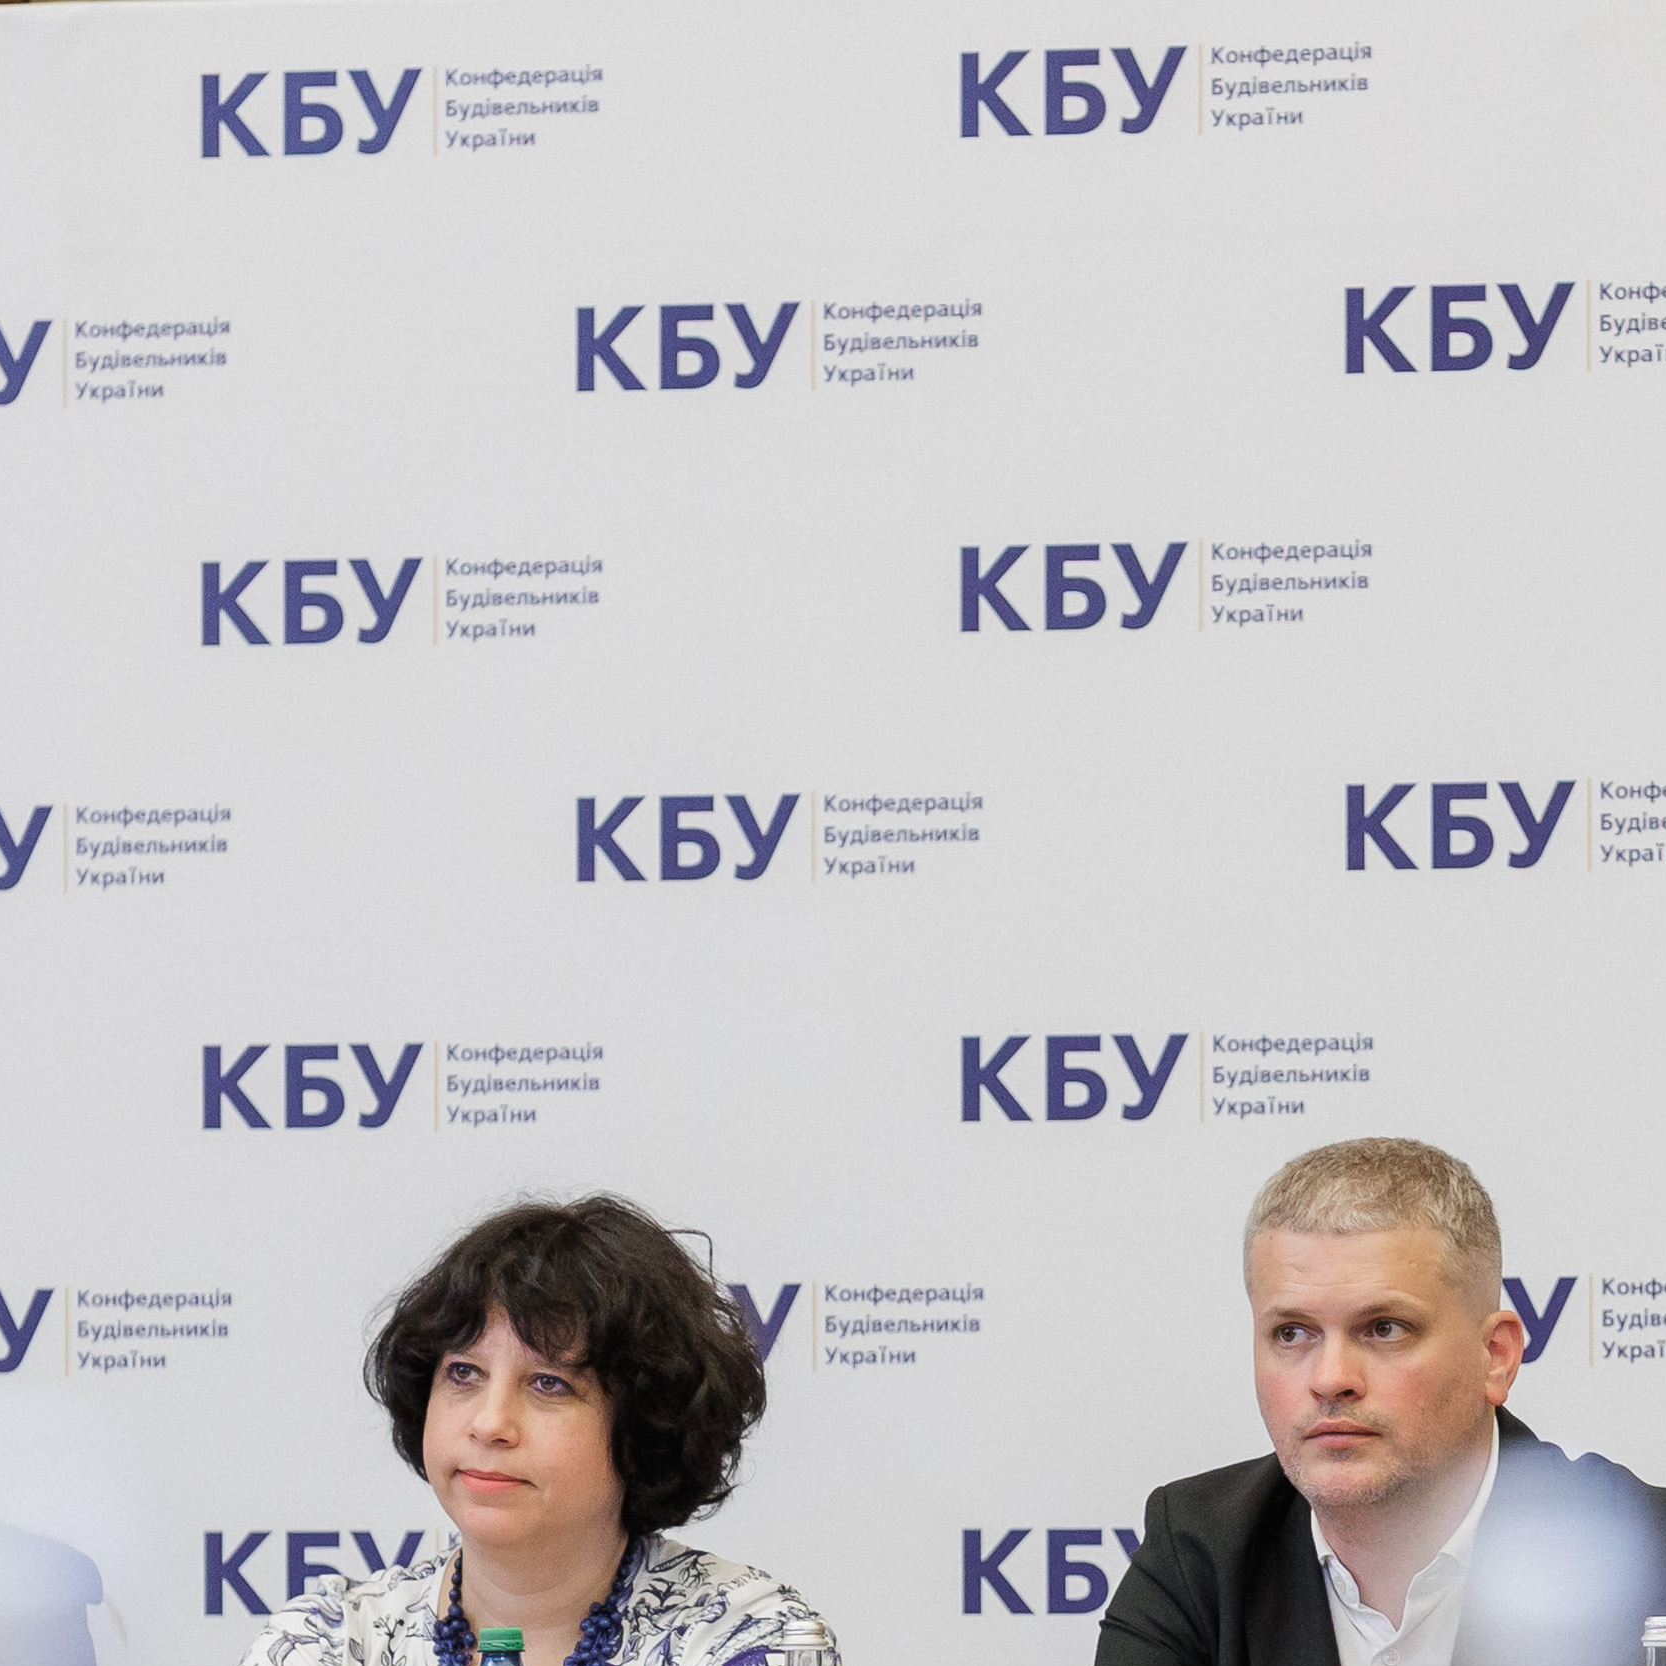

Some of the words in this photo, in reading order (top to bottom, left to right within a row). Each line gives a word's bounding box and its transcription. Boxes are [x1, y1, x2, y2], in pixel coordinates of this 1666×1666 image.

[445, 64, 604, 90] Конфедерація
[960, 45, 1187, 138] КБУ
[201, 68, 422, 159] КБУ
[445, 95, 600, 122] Будівельників
[445, 128, 536, 152] України
[75, 316, 231, 342] Конфедерація
[1345, 281, 1575, 374] КБУ
[576, 302, 800, 392] КБУ
[75, 348, 228, 374] Будівельників
[75, 380, 165, 404] України
[960, 542, 1188, 633] КБУ
[201, 557, 423, 647] КБУ
[824, 791, 984, 817] Конфедерація
[576, 793, 800, 883] КБУ
[824, 823, 980, 849] Будівельників
[1346, 780, 1576, 871] КБУ
[823, 855, 916, 879] України
[1212, 1032, 1374, 1057] Конфедерація
[202, 1042, 424, 1130] КБУ
[961, 1033, 1189, 1122] КБУ
[1212, 1063, 1371, 1089] Будівельників
[1212, 1096, 1305, 1120] України
[77, 1288, 233, 1312] Конфедерація
[77, 1319, 230, 1344] Будівельників
[77, 1350, 167, 1374] України
[962, 1528, 1141, 1614] КБ
